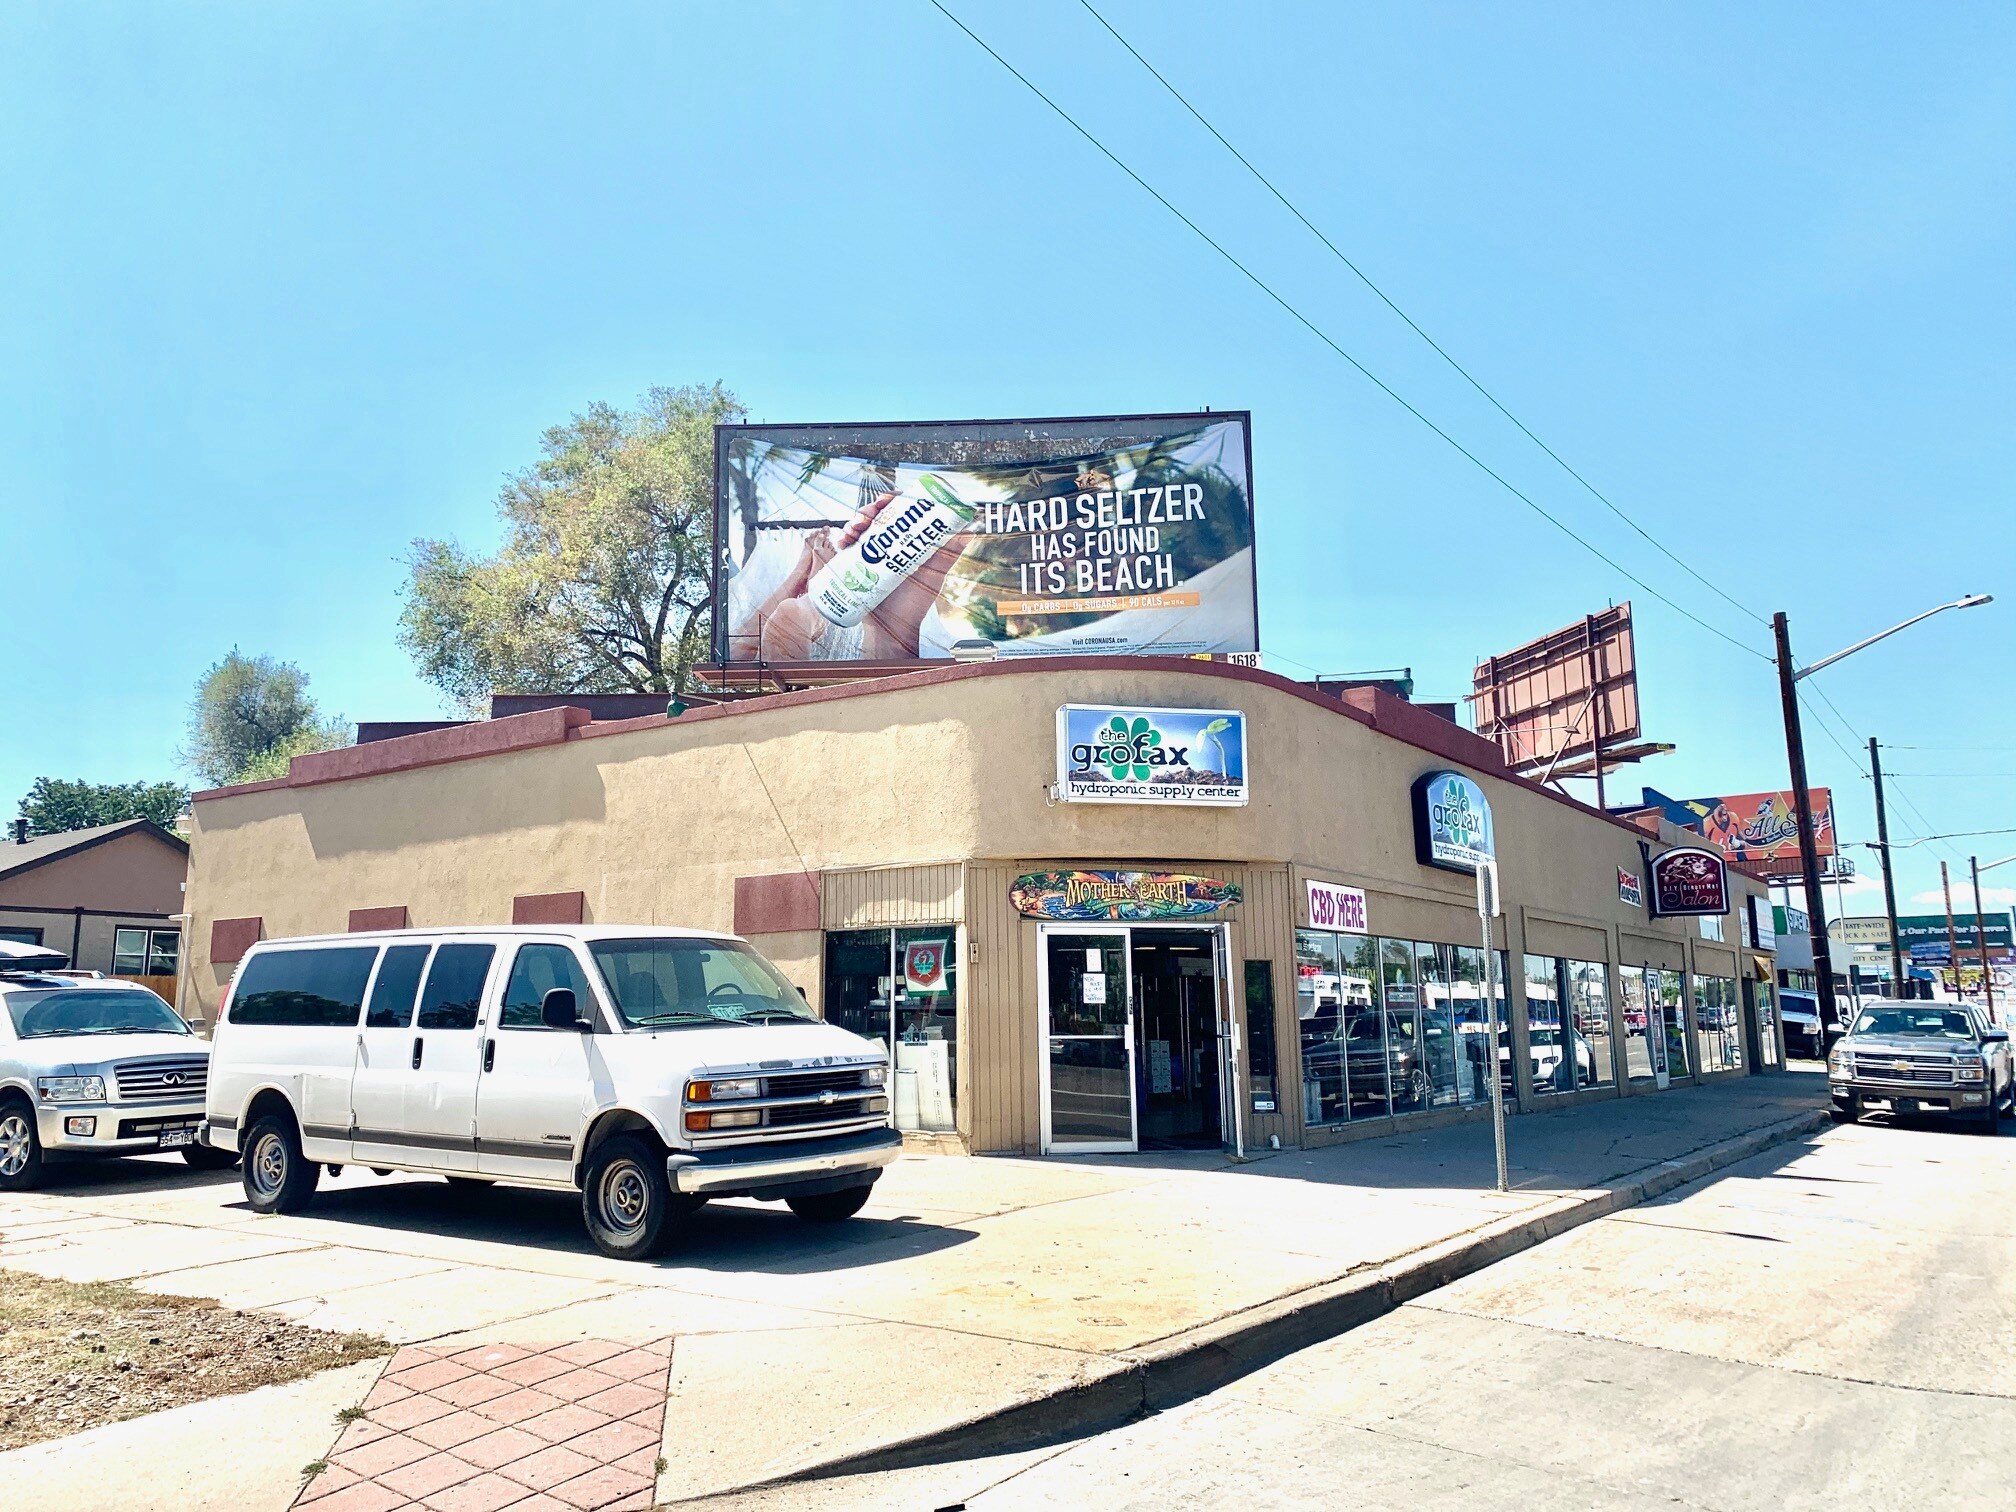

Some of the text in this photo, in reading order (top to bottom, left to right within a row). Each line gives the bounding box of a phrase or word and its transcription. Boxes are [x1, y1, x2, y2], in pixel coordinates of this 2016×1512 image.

[985, 484, 1206, 534] HARD SELTZER
[861, 498, 936, 564] Corona
[885, 517, 949, 574] SELTZER
[1031, 527, 1160, 561] HAS FOUND
[1020, 553, 1184, 595] ITS BEACH.
[1034, 602, 1061, 612] CARBS
[1085, 600, 1117, 610] SUGARS
[1129, 598, 1139, 607] 90
[1141, 597, 1162, 607] CALS
[1072, 637, 1128, 646] Visit CORONAUSA.com
[1231, 653, 1257, 668] 1618
[1101, 728, 1126, 742] the
[1071, 733, 1190, 772] grofax
[1071, 781, 1241, 799] hydroponic supply center
[1432, 798, 1481, 834] grofax
[1744, 814, 1781, 837] All
[1434, 842, 1469, 860] hydroponic
[1065, 879, 1188, 908] MOTHER EARTH
[1661, 879, 1720, 909] Salon
[1311, 888, 1365, 929] CBD HERE
[1907, 926, 1927, 935] Our
